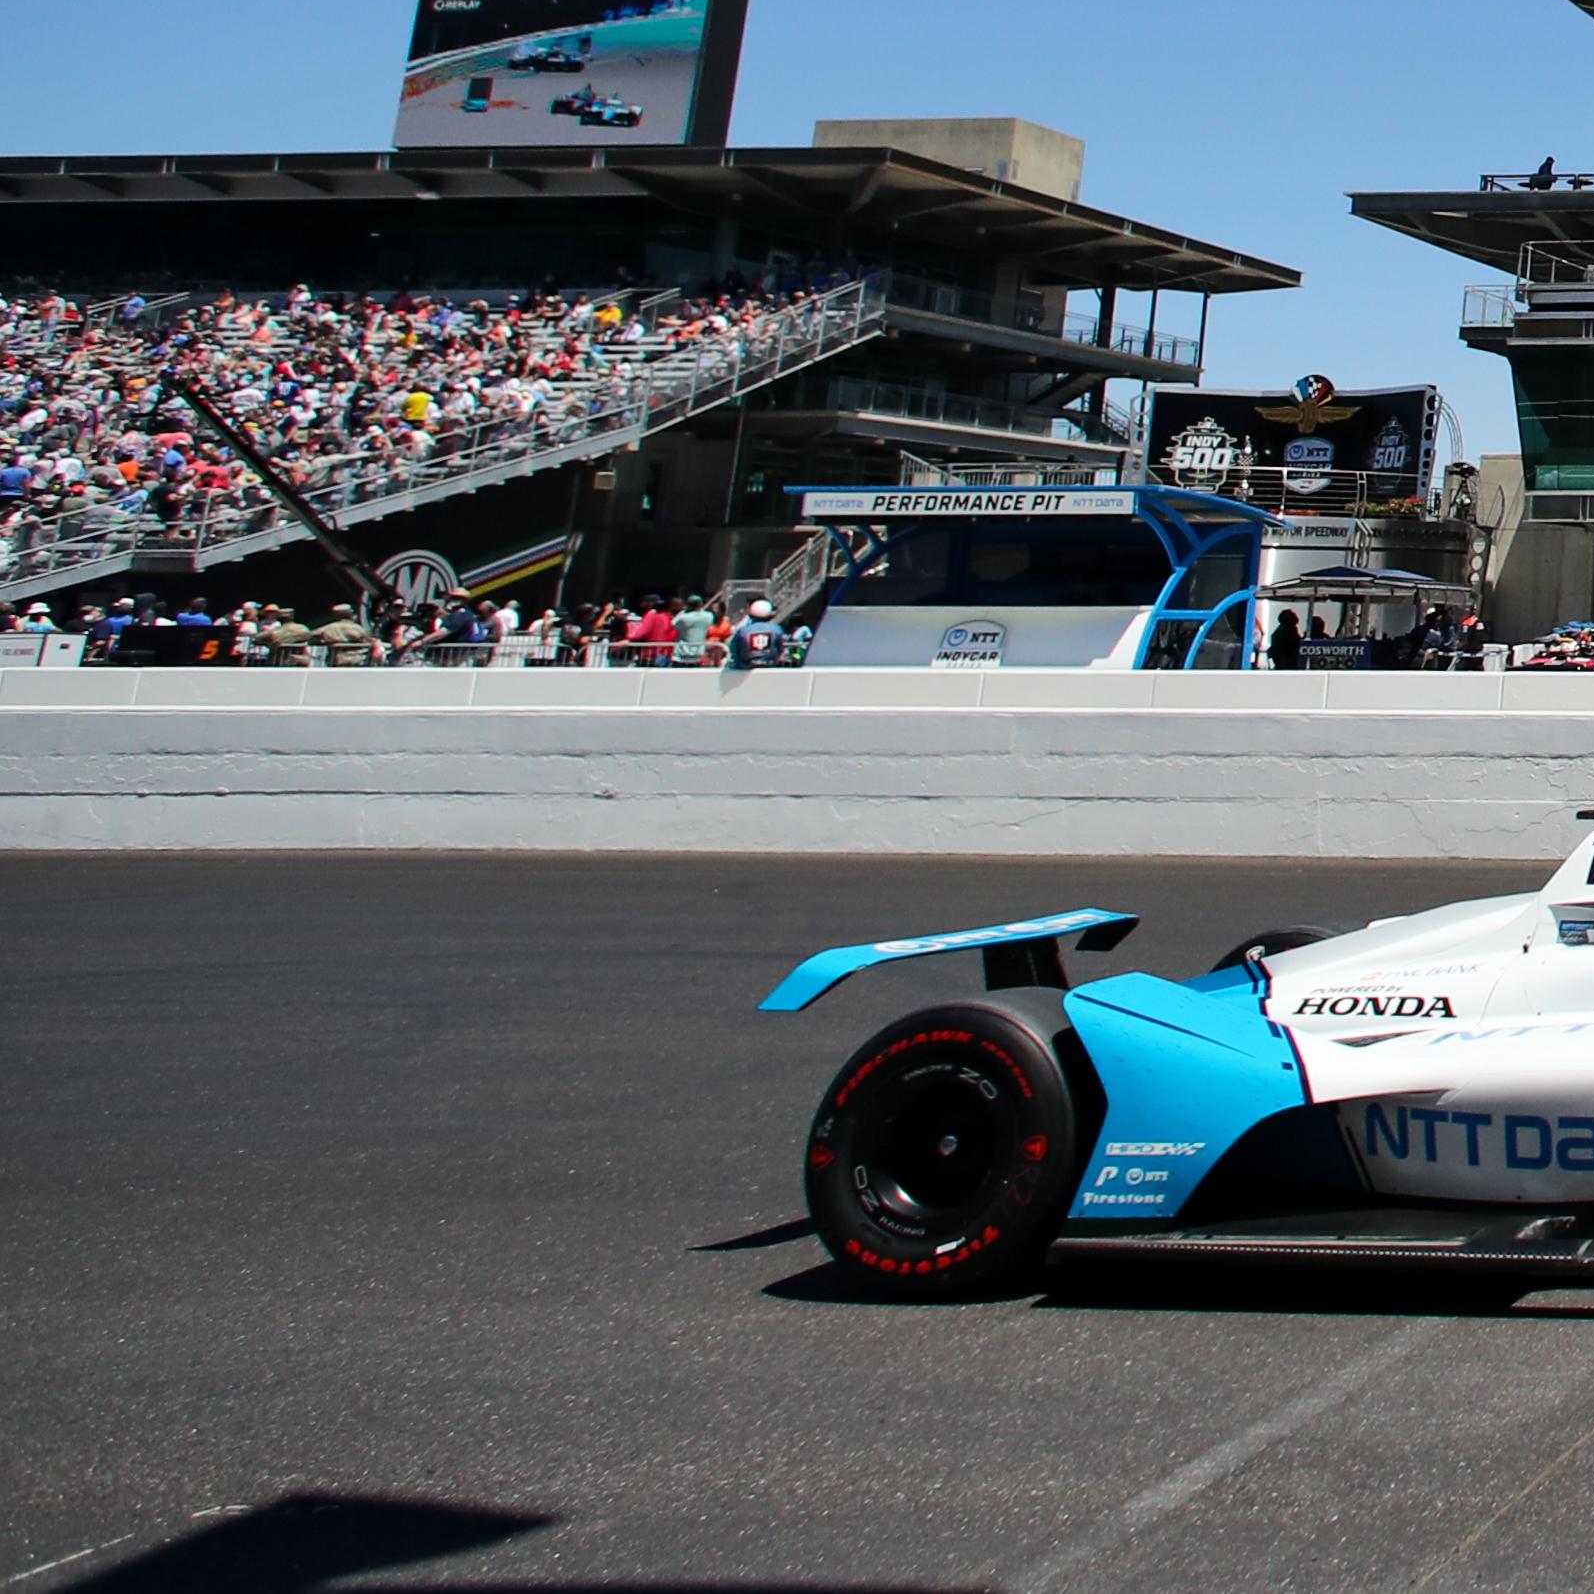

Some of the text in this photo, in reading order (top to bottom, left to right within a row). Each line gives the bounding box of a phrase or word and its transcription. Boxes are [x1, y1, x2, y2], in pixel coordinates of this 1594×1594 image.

[1185, 435, 1221, 447] INDY
[1172, 448, 1232, 470] 500
[1306, 447, 1330, 457] NTT
[1374, 447, 1405, 468] 500
[872, 494, 1027, 512] PERFORMANCE
[1032, 494, 1065, 511] PIT
[1303, 526, 1348, 538] SPEEDWAY
[970, 632, 1000, 643] NTT
[936, 651, 999, 661] INDYCAR
[1299, 645, 1365, 656] COSWORTH
[1426, 963, 1485, 977] BANK
[1311, 984, 1385, 994] POWERED
[1292, 995, 1458, 1018] HONDA
[836, 1030, 976, 1107] FIREHAWK
[1363, 1101, 1492, 1167] NTT
[1082, 1191, 1166, 1206] Firestone
[879, 1215, 927, 1237] RACING
